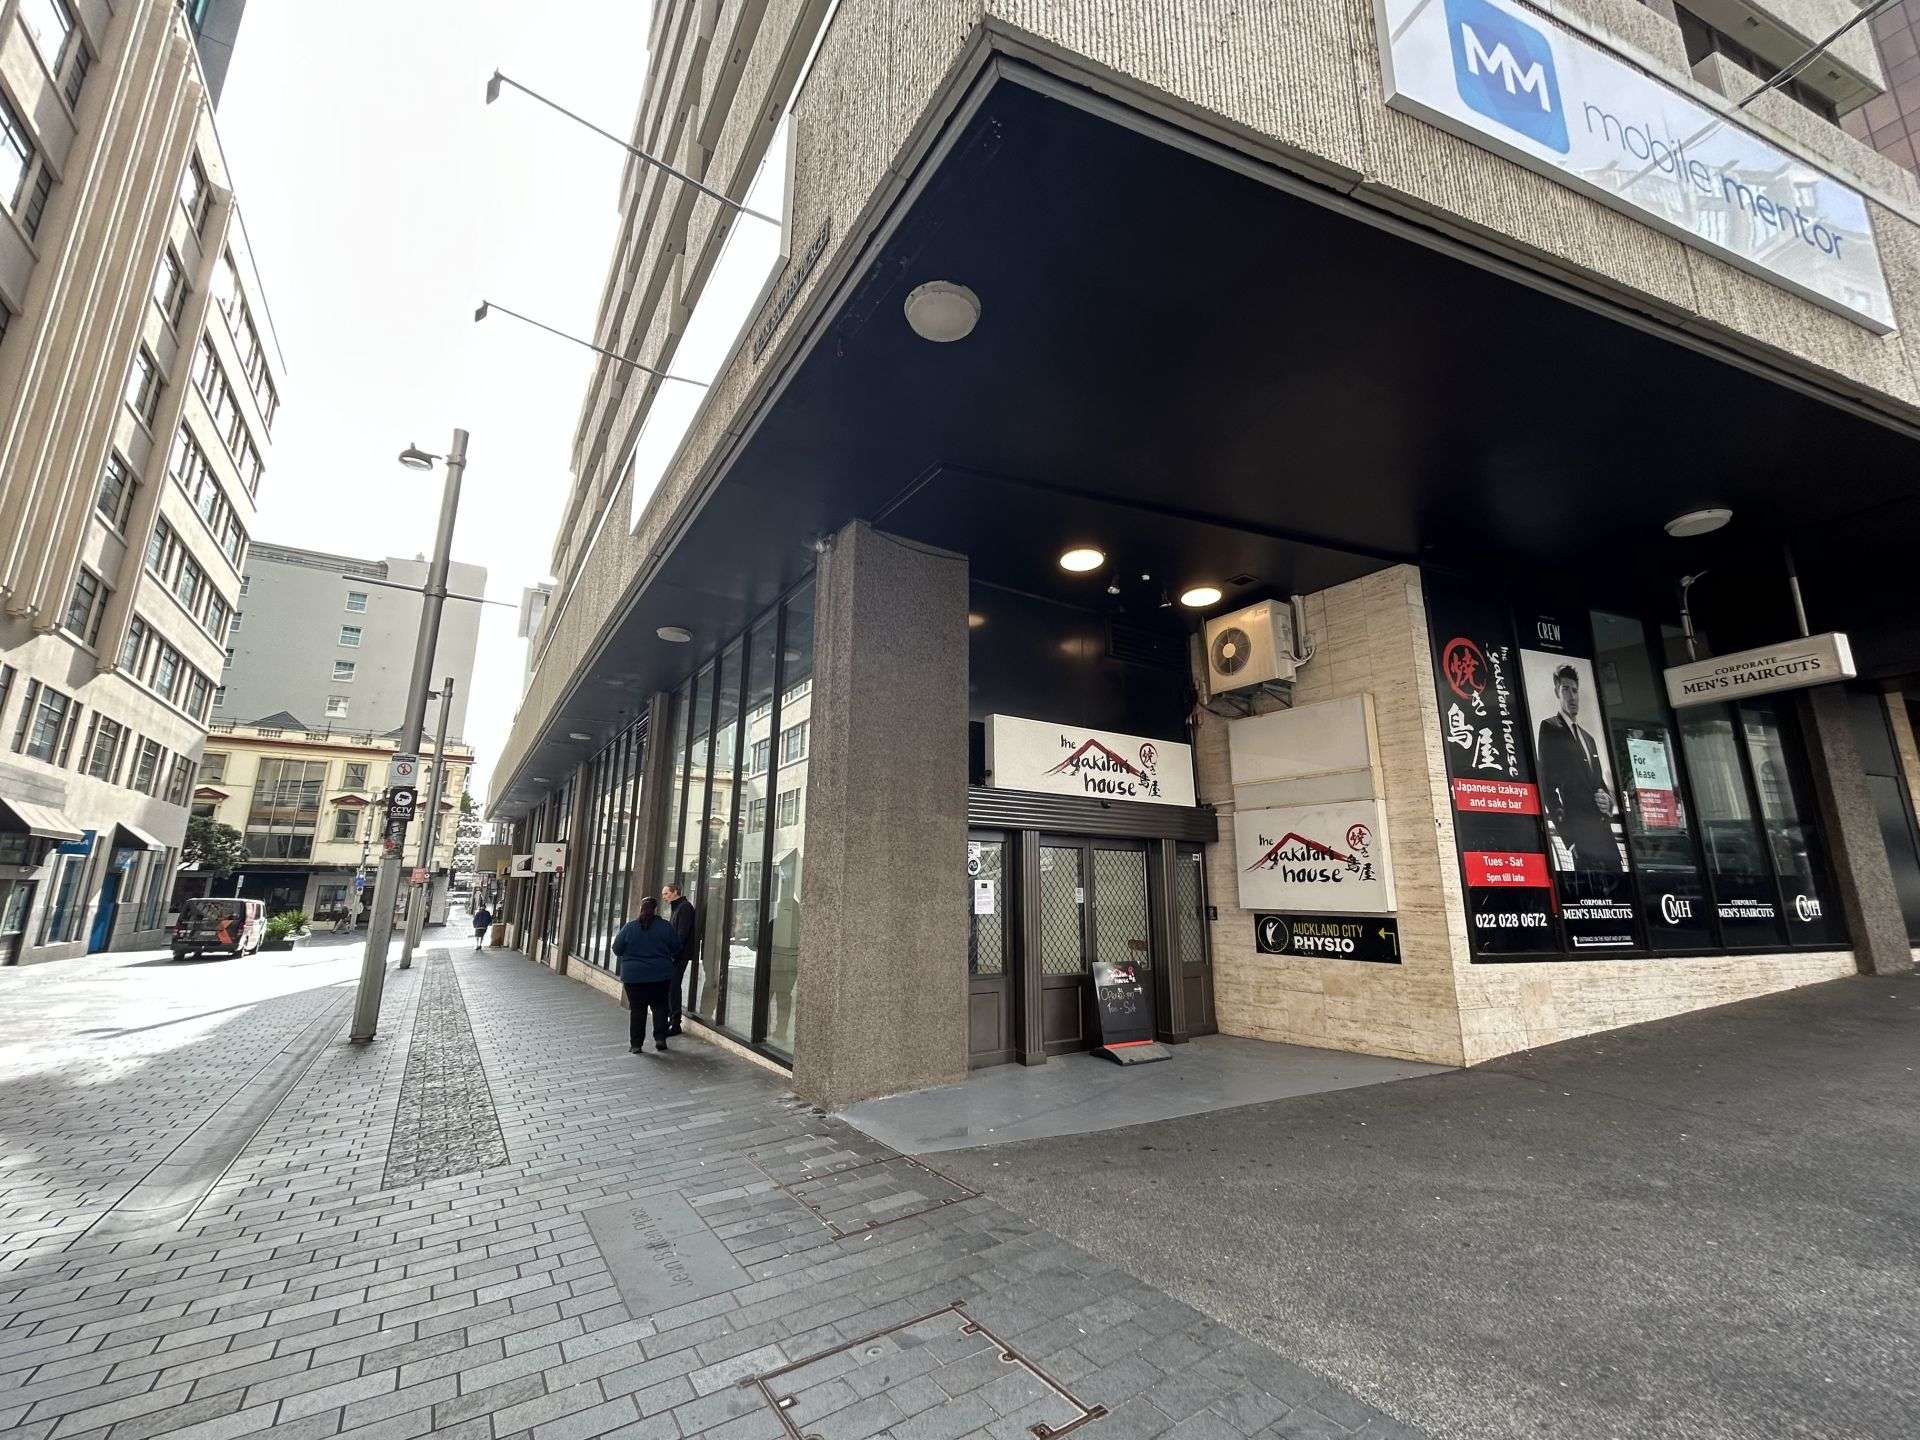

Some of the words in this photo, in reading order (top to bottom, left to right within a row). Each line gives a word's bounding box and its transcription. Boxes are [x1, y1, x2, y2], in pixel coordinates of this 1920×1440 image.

[1583, 101, 1711, 193] mobile
[1721, 173, 1844, 261] mentor
[1537, 622, 1561, 641] CREW
[1714, 656, 1778, 676] CORPORATE
[1683, 677, 1729, 695] MEN'S
[1732, 658, 1821, 685] HAIRCUTS
[1487, 647, 1511, 716] yakitori
[1501, 719, 1519, 777] house
[1633, 754, 1646, 766] For
[1636, 768, 1656, 780] lease
[1083, 772, 1137, 797] house
[1457, 781, 1497, 793] Japanese
[1498, 783, 1529, 797] izakaya
[391, 806, 412, 814] CCTV
[1470, 797, 1486, 807] and
[1487, 798, 1508, 809] sake
[1509, 799, 1523, 809] bar
[1483, 856, 1504, 867] Tues
[1509, 856, 1524, 867] Sat
[1282, 864, 1344, 883] house
[1486, 873, 1502, 884] 5pm
[1502, 873, 1512, 882] till
[1512, 873, 1525, 882] late
[1563, 908, 1590, 919] MEN'S
[1590, 908, 1633, 919] HAIRCUTS
[1661, 894, 1693, 924] CMH
[1718, 907, 1740, 918] MEN'S
[1740, 907, 1775, 918] HAIRCUTS
[1796, 894, 1822, 922] CMH
[1475, 913, 1497, 928] 022
[1498, 913, 1519, 928] 028
[1520, 913, 1548, 928] 0672
[1292, 922, 1341, 938] AUCKLAND
[1341, 923, 1364, 939] CITY
[1293, 935, 1355, 953] PHYSIO
[665, 1259, 694, 1287] Jean
